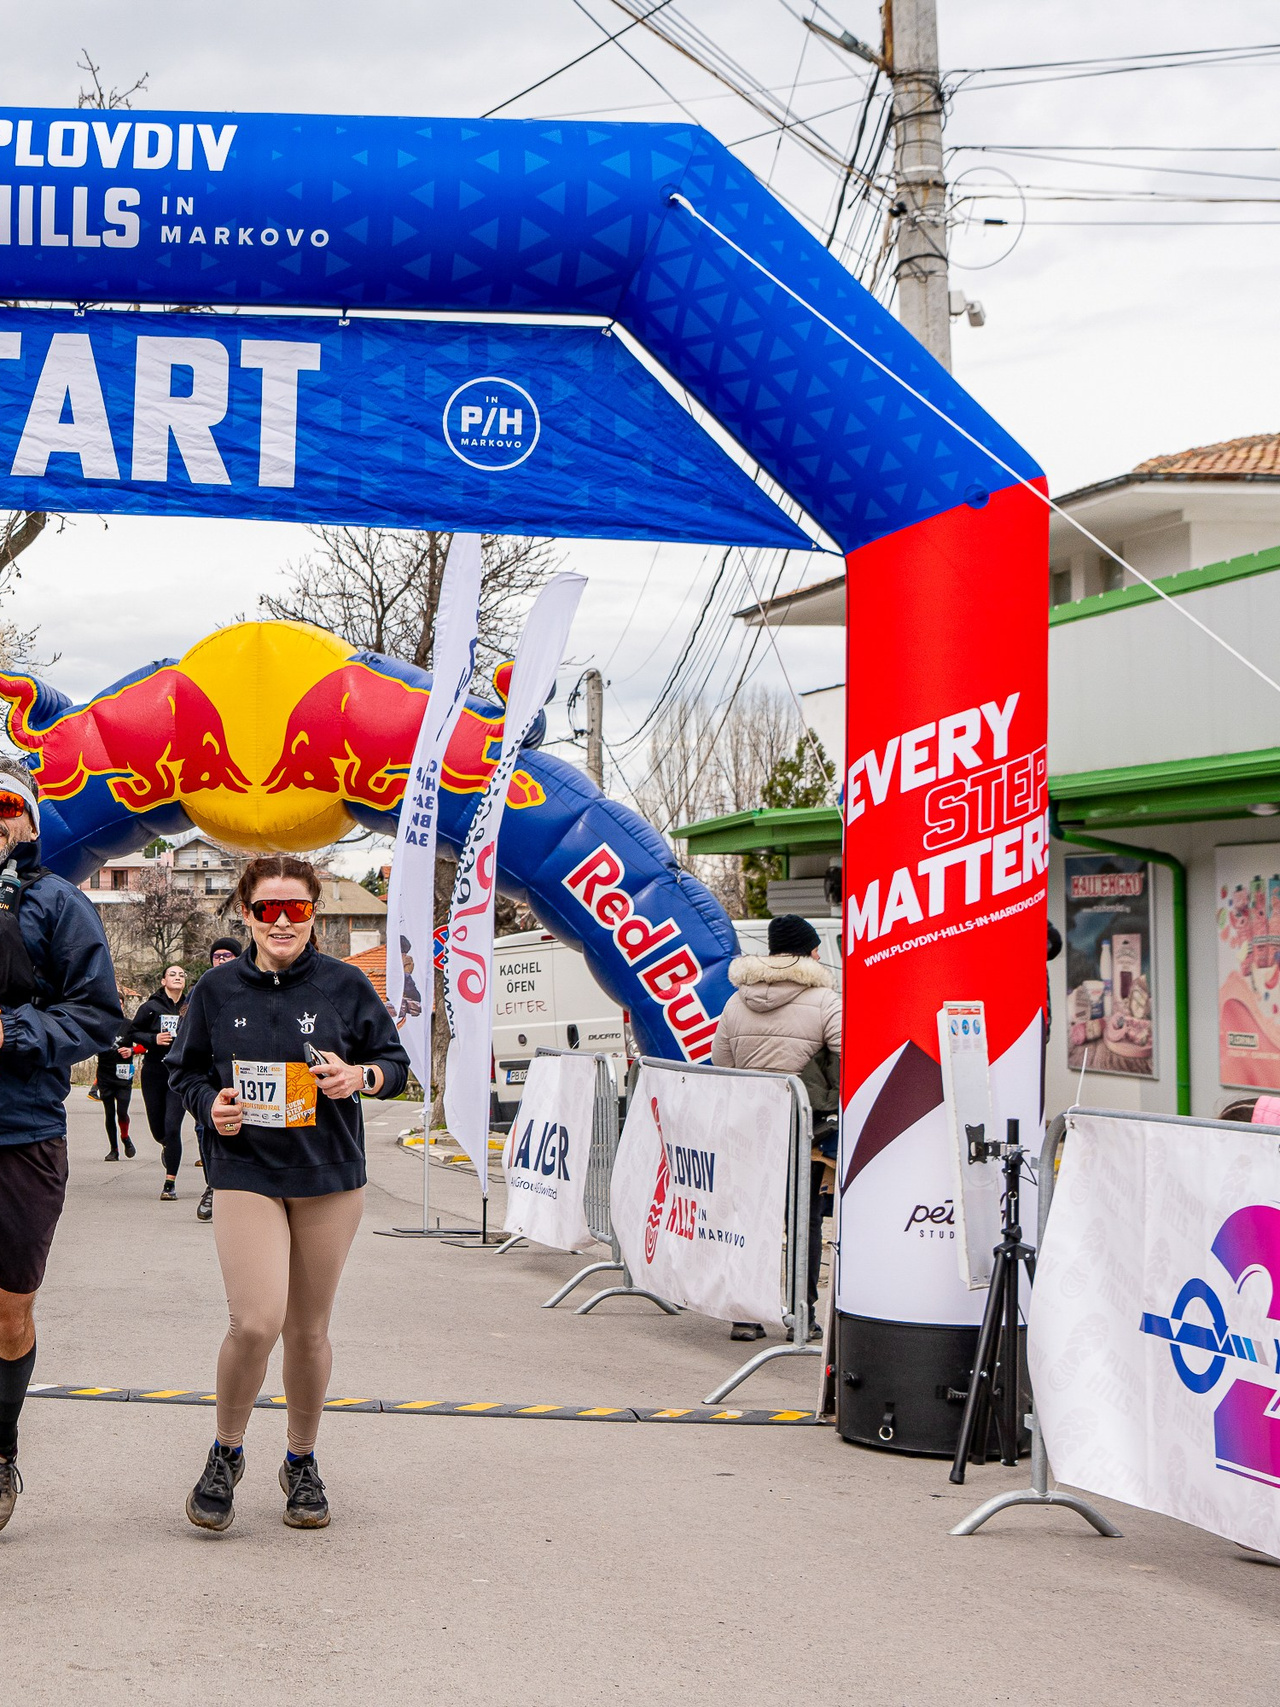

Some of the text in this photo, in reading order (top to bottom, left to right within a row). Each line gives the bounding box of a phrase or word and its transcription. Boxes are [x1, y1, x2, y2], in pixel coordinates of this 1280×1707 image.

[161, 196, 194, 215] IN
[160, 225, 330, 248] MARKOVO
[485, 396, 499, 404] IN
[461, 405, 523, 437] P/H
[460, 438, 522, 449] MARKOVO
[847, 692, 1020, 826] EVERY
[923, 743, 1048, 850] STEP
[565, 846, 677, 963] Red
[499, 962, 542, 977] KACHEL
[507, 979, 535, 993] ÖFEN
[496, 1000, 547, 1016] LEITER
[588, 1033, 621, 1041] DUCATO
[240, 1080, 276, 1102] 1317
[698, 1208, 708, 1221] IN
